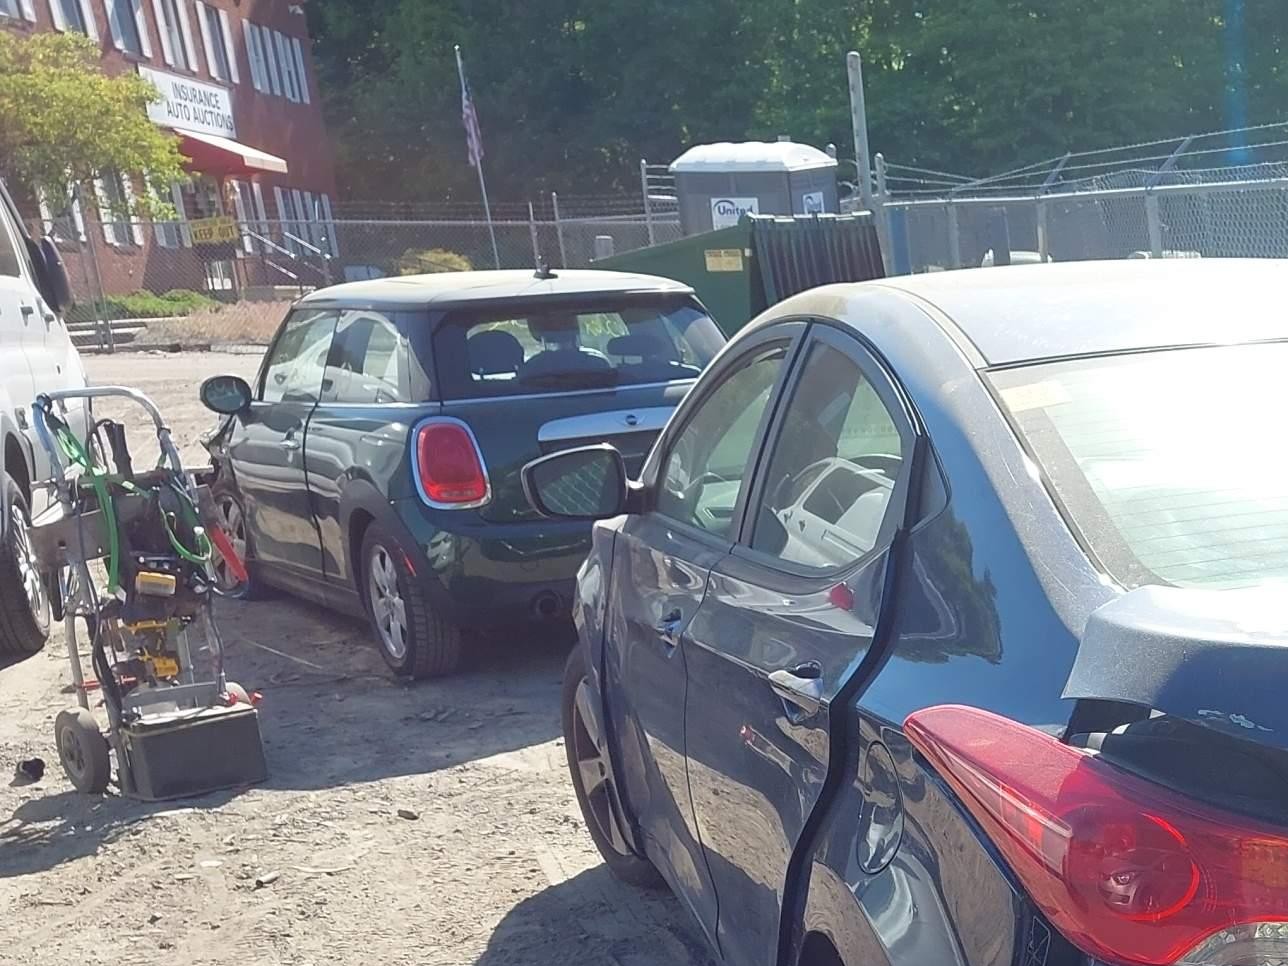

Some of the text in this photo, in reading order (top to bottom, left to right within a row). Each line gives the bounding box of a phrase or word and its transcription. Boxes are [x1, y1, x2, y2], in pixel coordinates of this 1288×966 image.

[172, 82, 221, 110] INSURANCE
[167, 101, 234, 131] AUTO AUCTIONS
[717, 205, 753, 216] United
[193, 226, 234, 241] KEEP OUT
